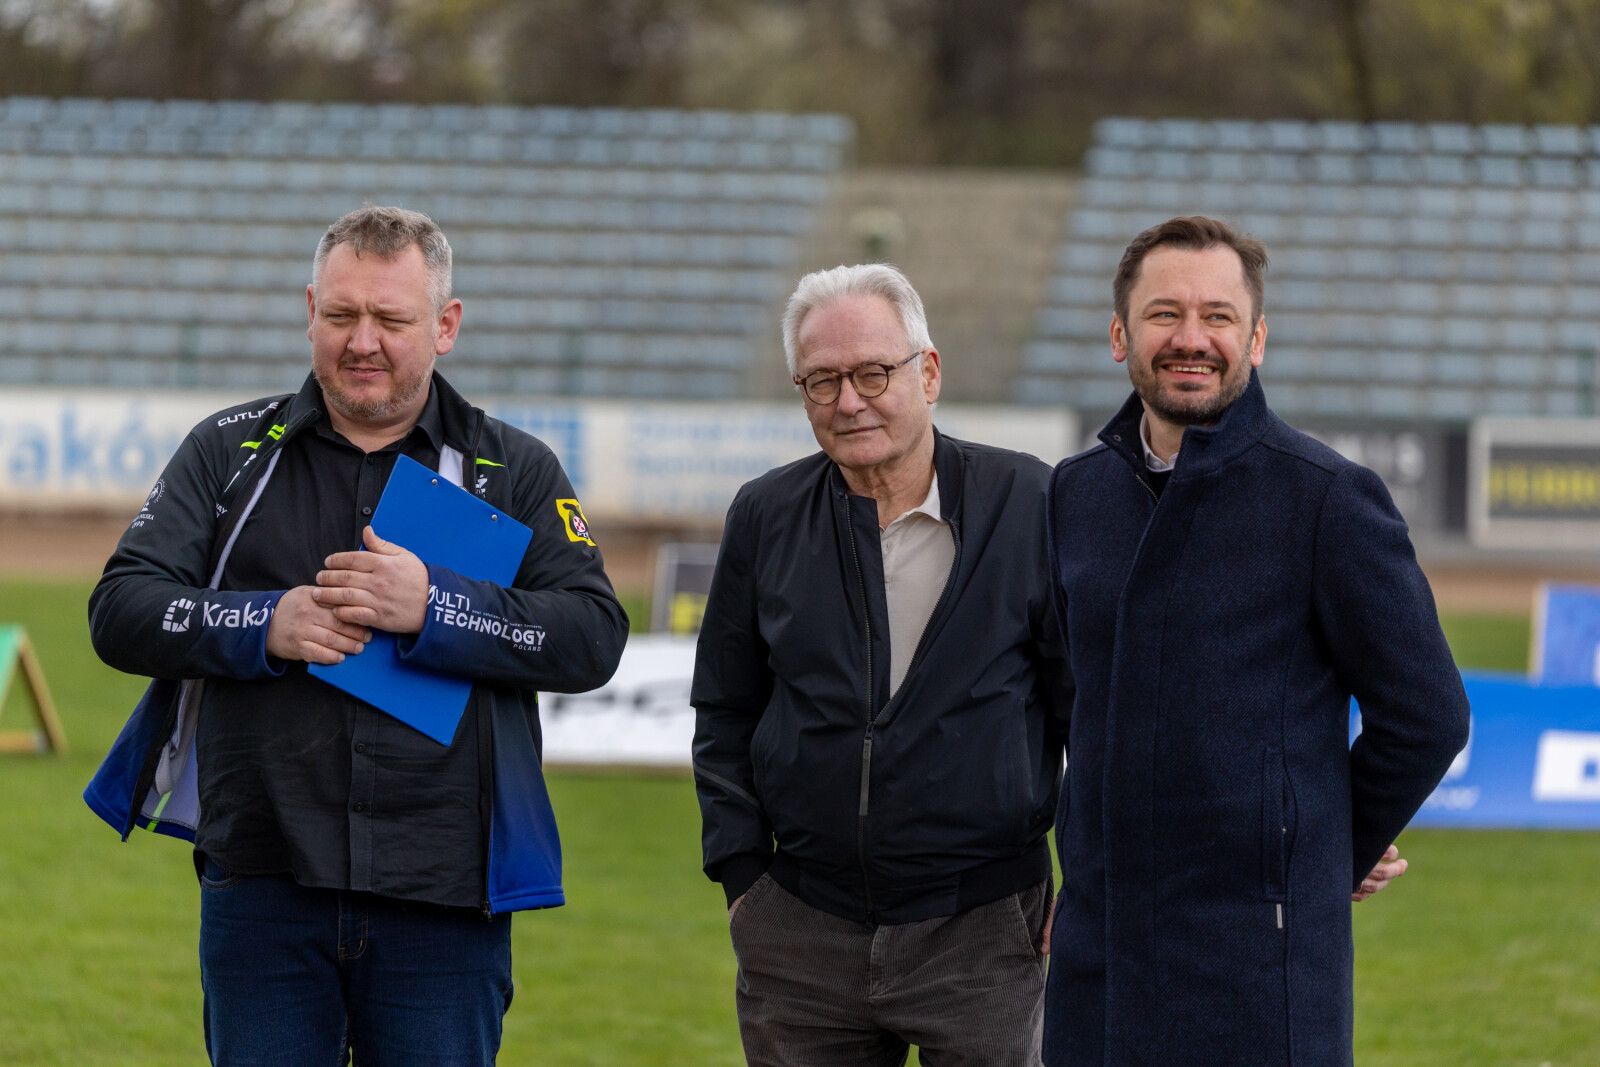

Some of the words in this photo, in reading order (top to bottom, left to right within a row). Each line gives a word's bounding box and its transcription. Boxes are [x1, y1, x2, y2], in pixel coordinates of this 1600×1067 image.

[202, 600, 275, 629] Krakó
[434, 605, 546, 646] TECHNOLOGY
[513, 643, 542, 652] POLAND
